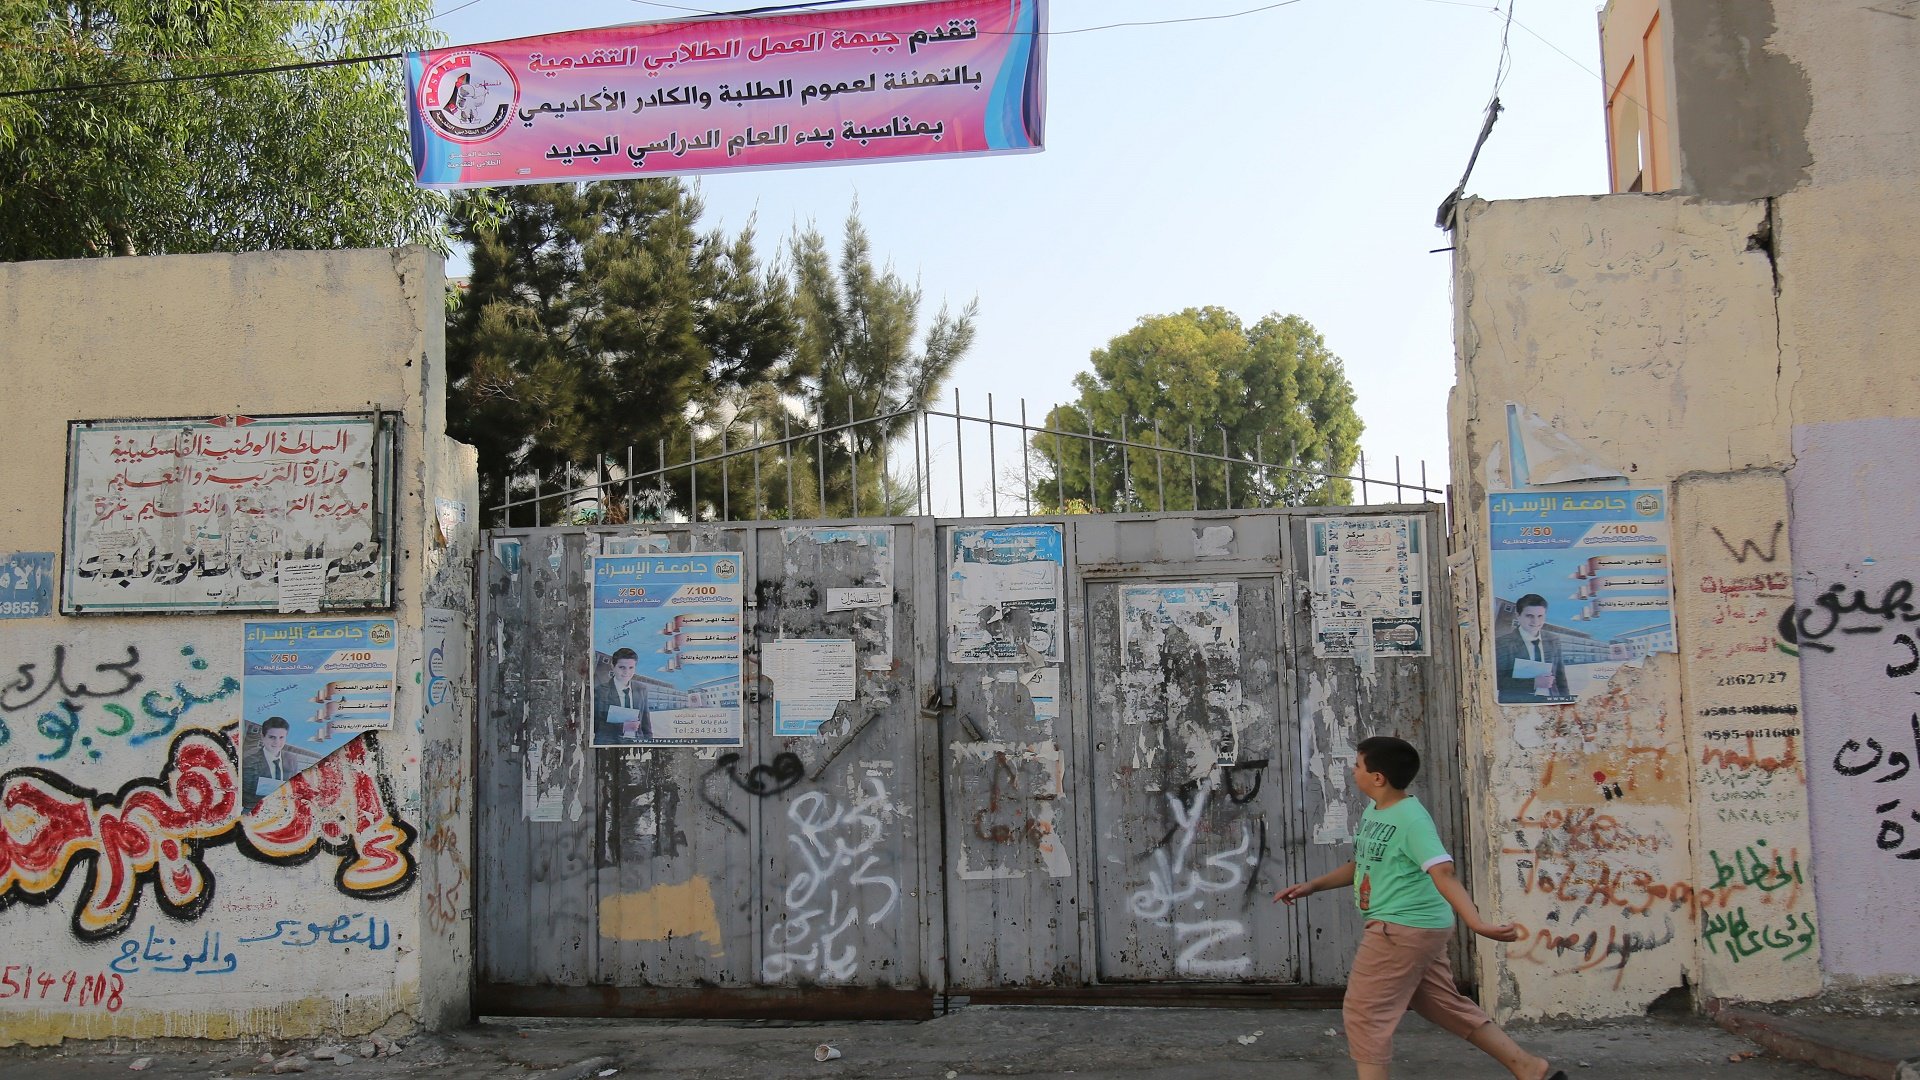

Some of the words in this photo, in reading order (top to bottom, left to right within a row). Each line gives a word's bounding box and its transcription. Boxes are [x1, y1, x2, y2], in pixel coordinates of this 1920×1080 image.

[747, 31, 825, 61] العمل
[830, 30, 901, 55] جبهة
[908, 19, 978, 54] تقدم
[528, 46, 638, 78] التقدمية
[643, 38, 742, 78] الطلابي
[800, 72, 876, 106] لعموم
[883, 64, 982, 91] بالتهنئة
[518, 86, 627, 127] الأكاديمي
[632, 85, 712, 114] والكادر
[719, 78, 793, 107] الطلبة
[727, 124, 788, 157] العام
[794, 126, 836, 149] بدء
[841, 115, 944, 147] بمناسبة
[545, 135, 619, 166] الجديد
[627, 128, 721, 167] الدراسي
[110, 433, 203, 463] الفلسطينية
[202, 430, 277, 460] الوطنية
[277, 428, 348, 455] السلطة
[203, 462, 298, 489] التربية
[303, 458, 349, 486] وزارة
[314, 494, 369, 520] مديرية
[1493, 497, 1557, 518] الإسراء
[1563, 496, 1626, 512] جامعة
[597, 562, 650, 580] الإسراء
[654, 561, 708, 576] جامعة
[0, 601, 39, 615] 9855
[247, 627, 303, 646] الإسراء
[307, 625, 363, 641] جامعة
